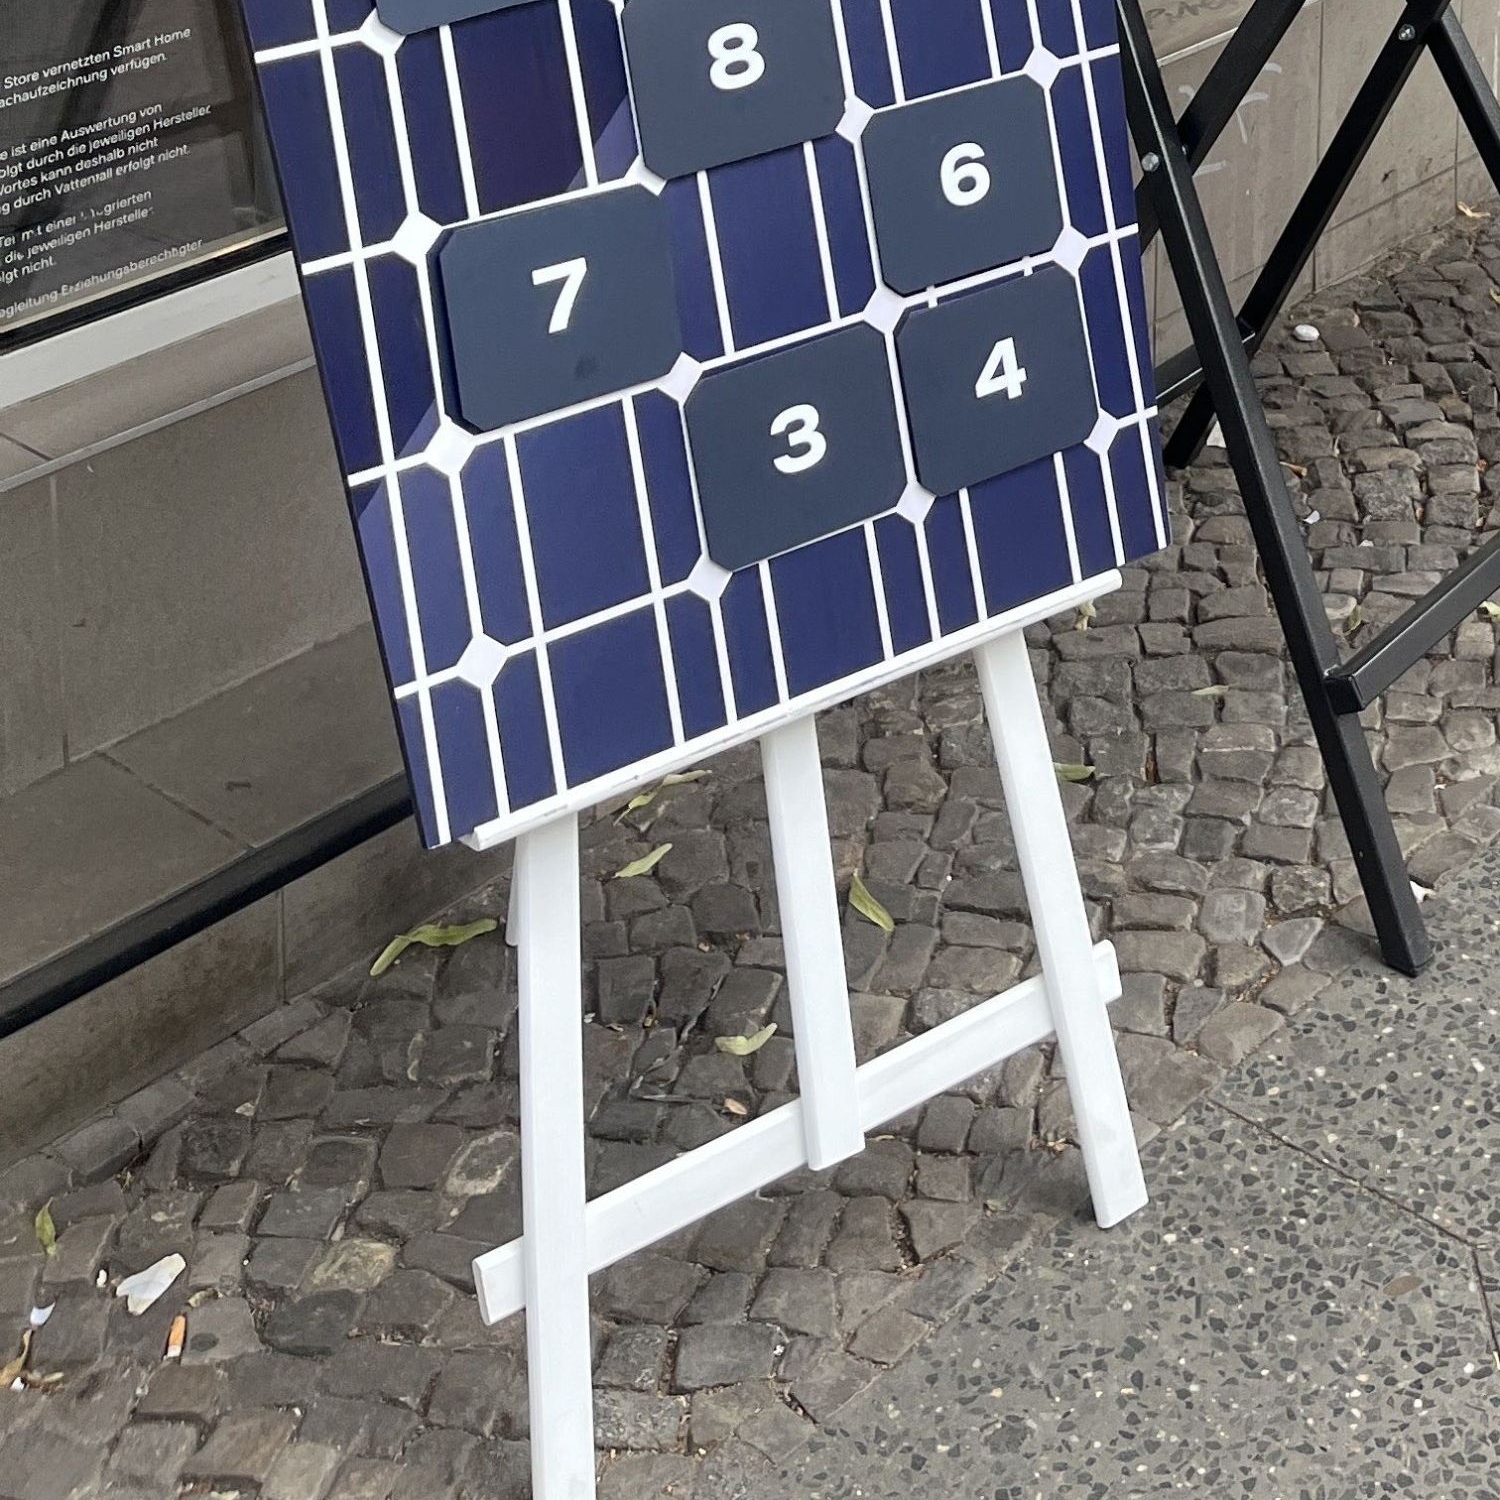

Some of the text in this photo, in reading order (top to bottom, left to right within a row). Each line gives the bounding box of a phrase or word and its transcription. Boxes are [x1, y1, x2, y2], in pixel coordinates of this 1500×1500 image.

[4, 28, 191, 90] Store vernetzten Smart Home
[110, 52, 167, 78] verfügen.
[707, 23, 765, 90] 8
[11, 143, 27, 157] ist
[30, 135, 57, 151] eine
[61, 111, 137, 142] Auswertung
[139, 103, 163, 119] von
[26, 148, 64, 170] durch
[67, 140, 86, 157] die
[88, 123, 151, 153] jeweiligen
[40, 164, 72, 183] kann
[75, 147, 125, 172] deshalb
[128, 136, 159, 158] nicht
[13, 188, 52, 210] durch
[54, 168, 113, 196] Vattenfall
[116, 154, 156, 178] erfolgt
[940, 142, 991, 207] 6
[27, 227, 91, 260] jeweiligen
[531, 257, 588, 334] 7
[975, 336, 1027, 400] 4
[770, 405, 827, 474] 3
